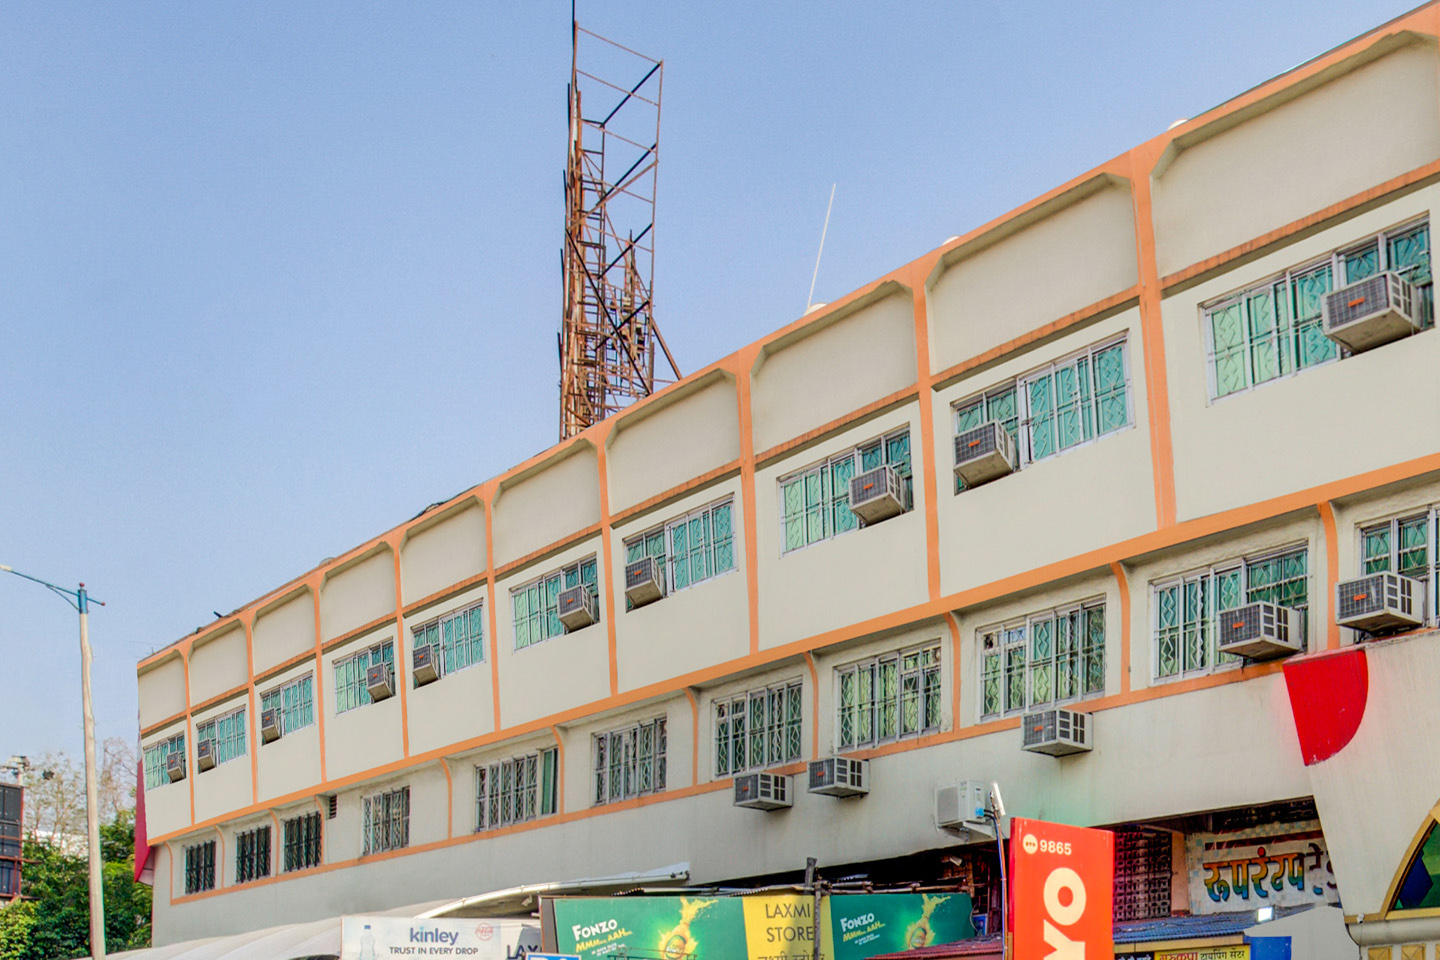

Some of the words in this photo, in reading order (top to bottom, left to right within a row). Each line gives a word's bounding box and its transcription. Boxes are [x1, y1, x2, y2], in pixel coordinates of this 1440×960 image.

[1040, 839, 1072, 856] 9865
[765, 903, 811, 918] LAXMI
[572, 919, 618, 941] FONZO
[840, 913, 875, 932] FONZO
[409, 926, 459, 946] kinley
[389, 946, 415, 955] TRUST
[418, 946, 427, 955] IN
[429, 947, 453, 955] EVERY
[456, 947, 478, 955] DROP
[507, 945, 542, 960] LAX
